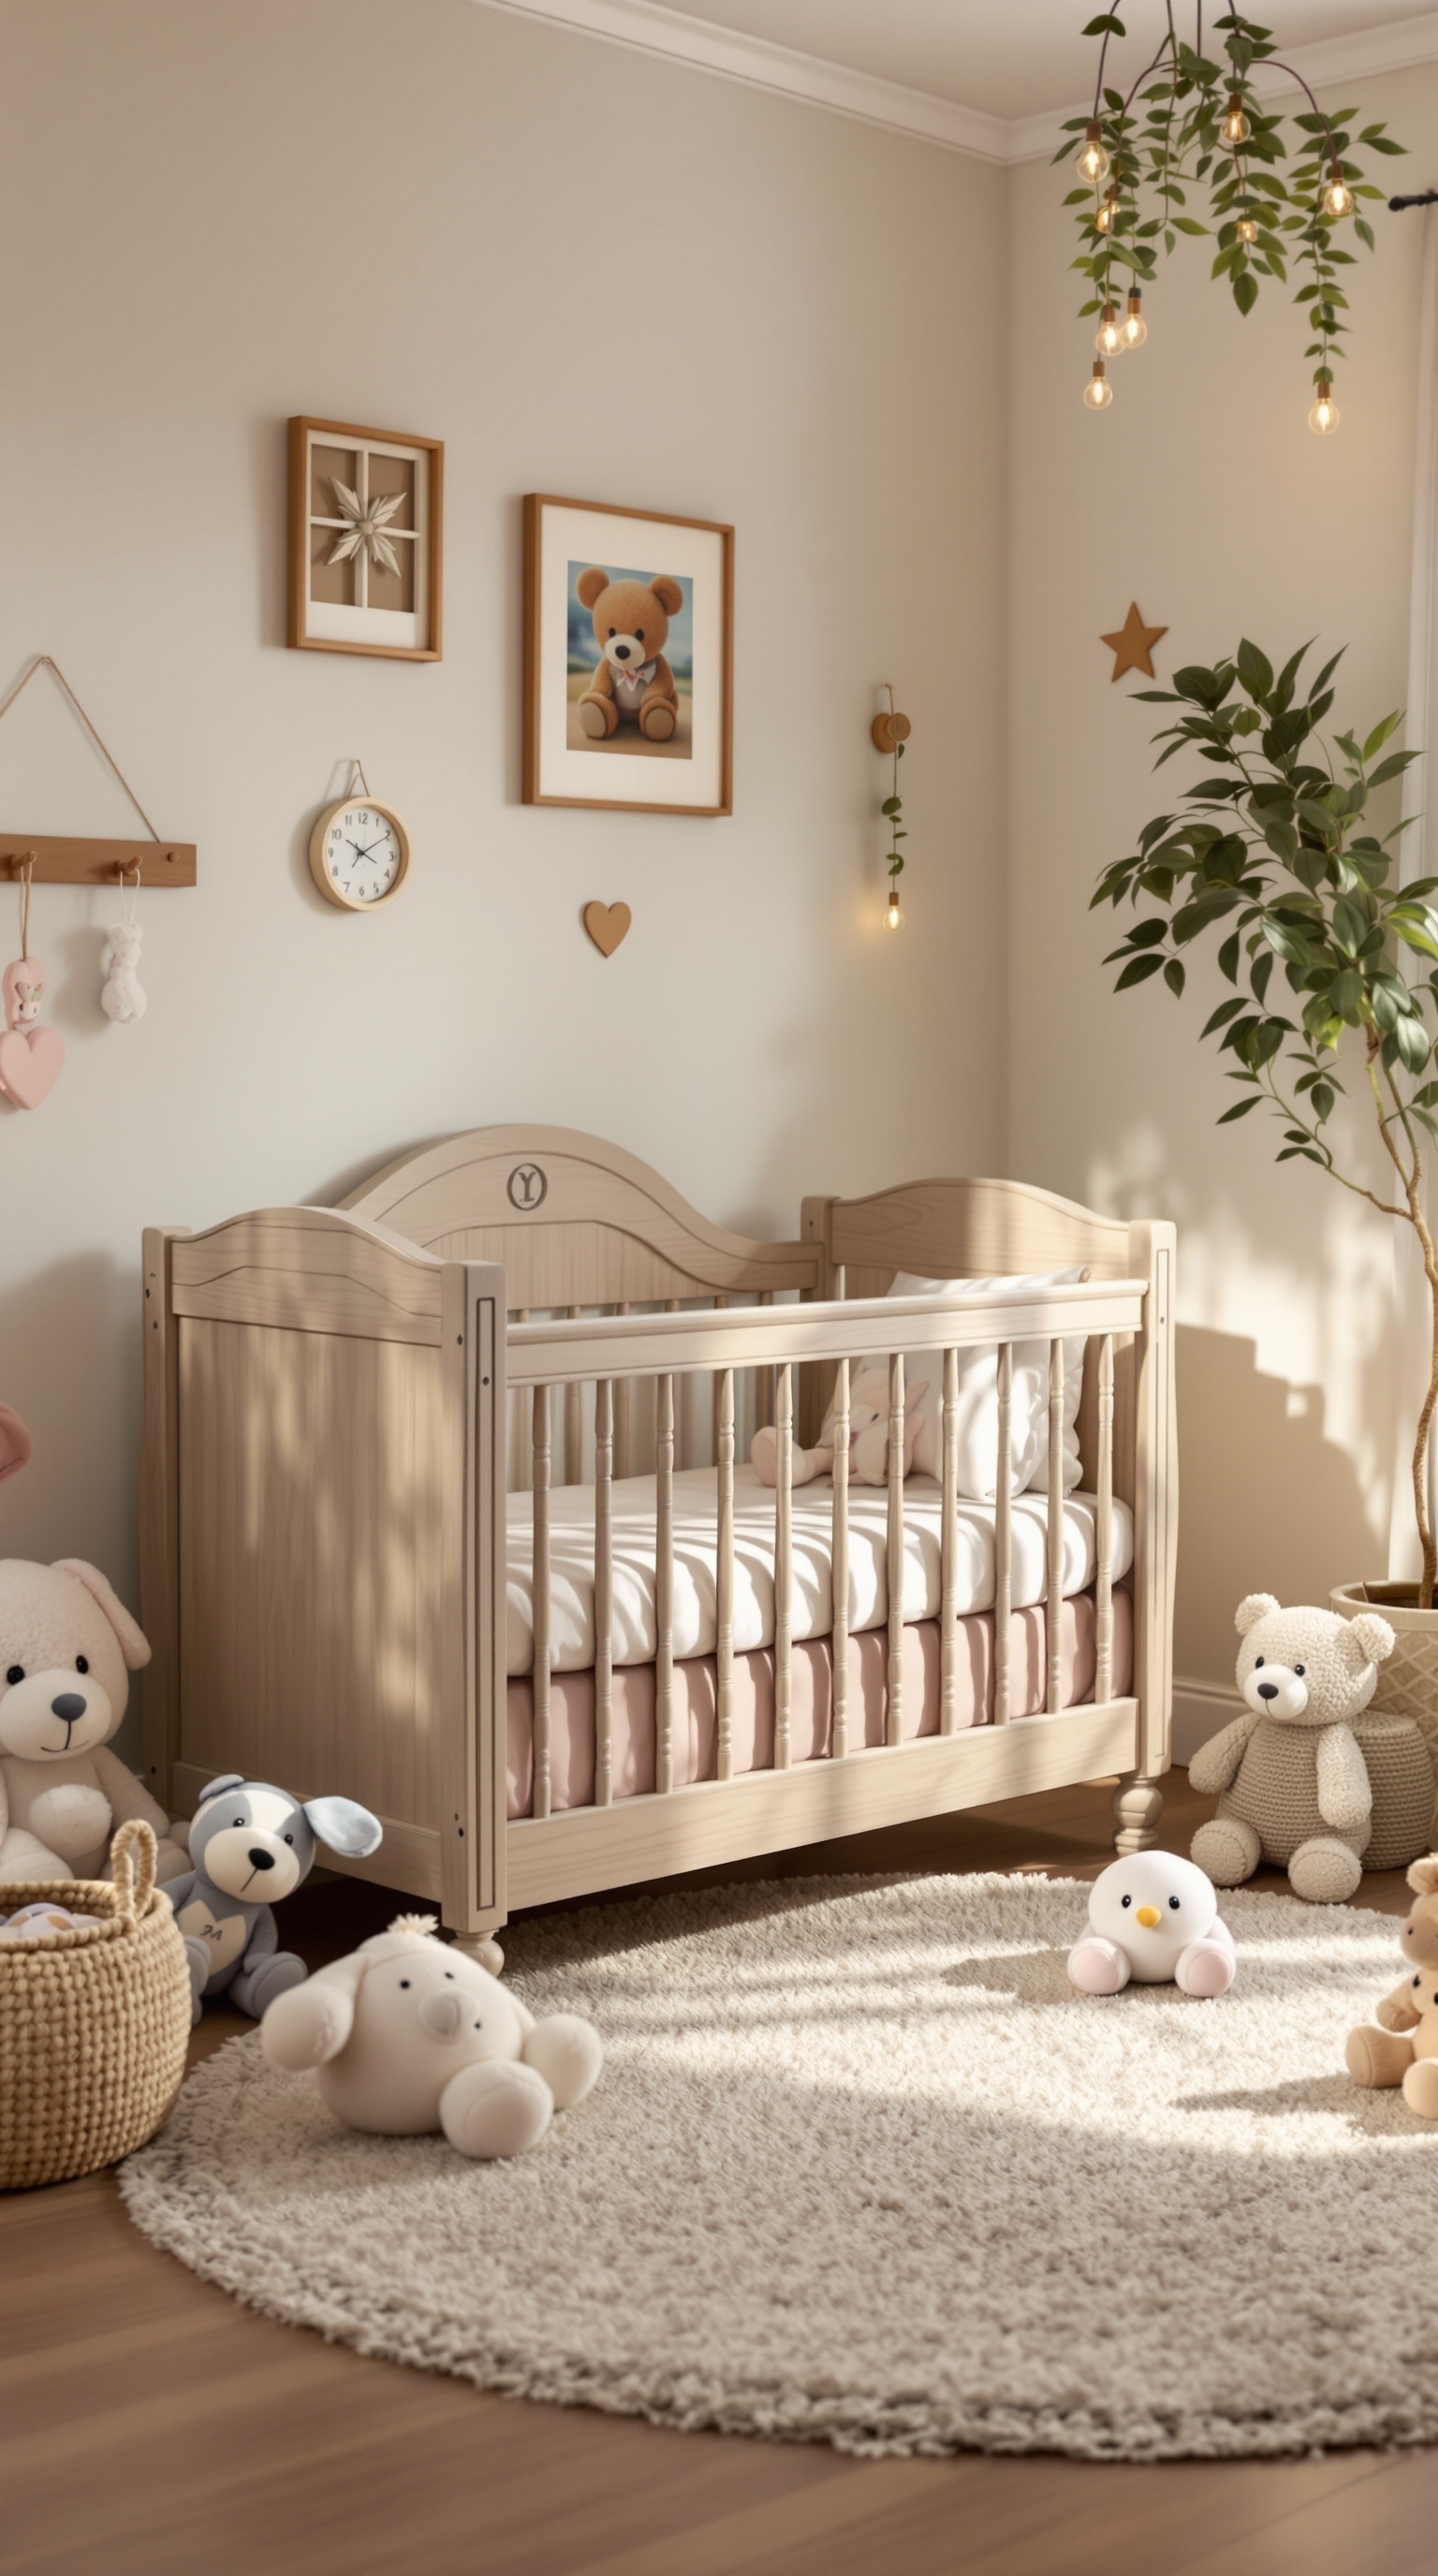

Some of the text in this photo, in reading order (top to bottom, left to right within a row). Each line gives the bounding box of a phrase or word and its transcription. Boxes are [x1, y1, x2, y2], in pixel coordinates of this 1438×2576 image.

[345, 814, 353, 827] 11
[358, 812, 368, 825] 12
[331, 828, 343, 840] 10
[385, 829, 391, 842] 2
[331, 866, 338, 877] 8
[343, 882, 350, 894] 7
[359, 886, 365, 897] 6
[518, 1171, 536, 1202] Y
